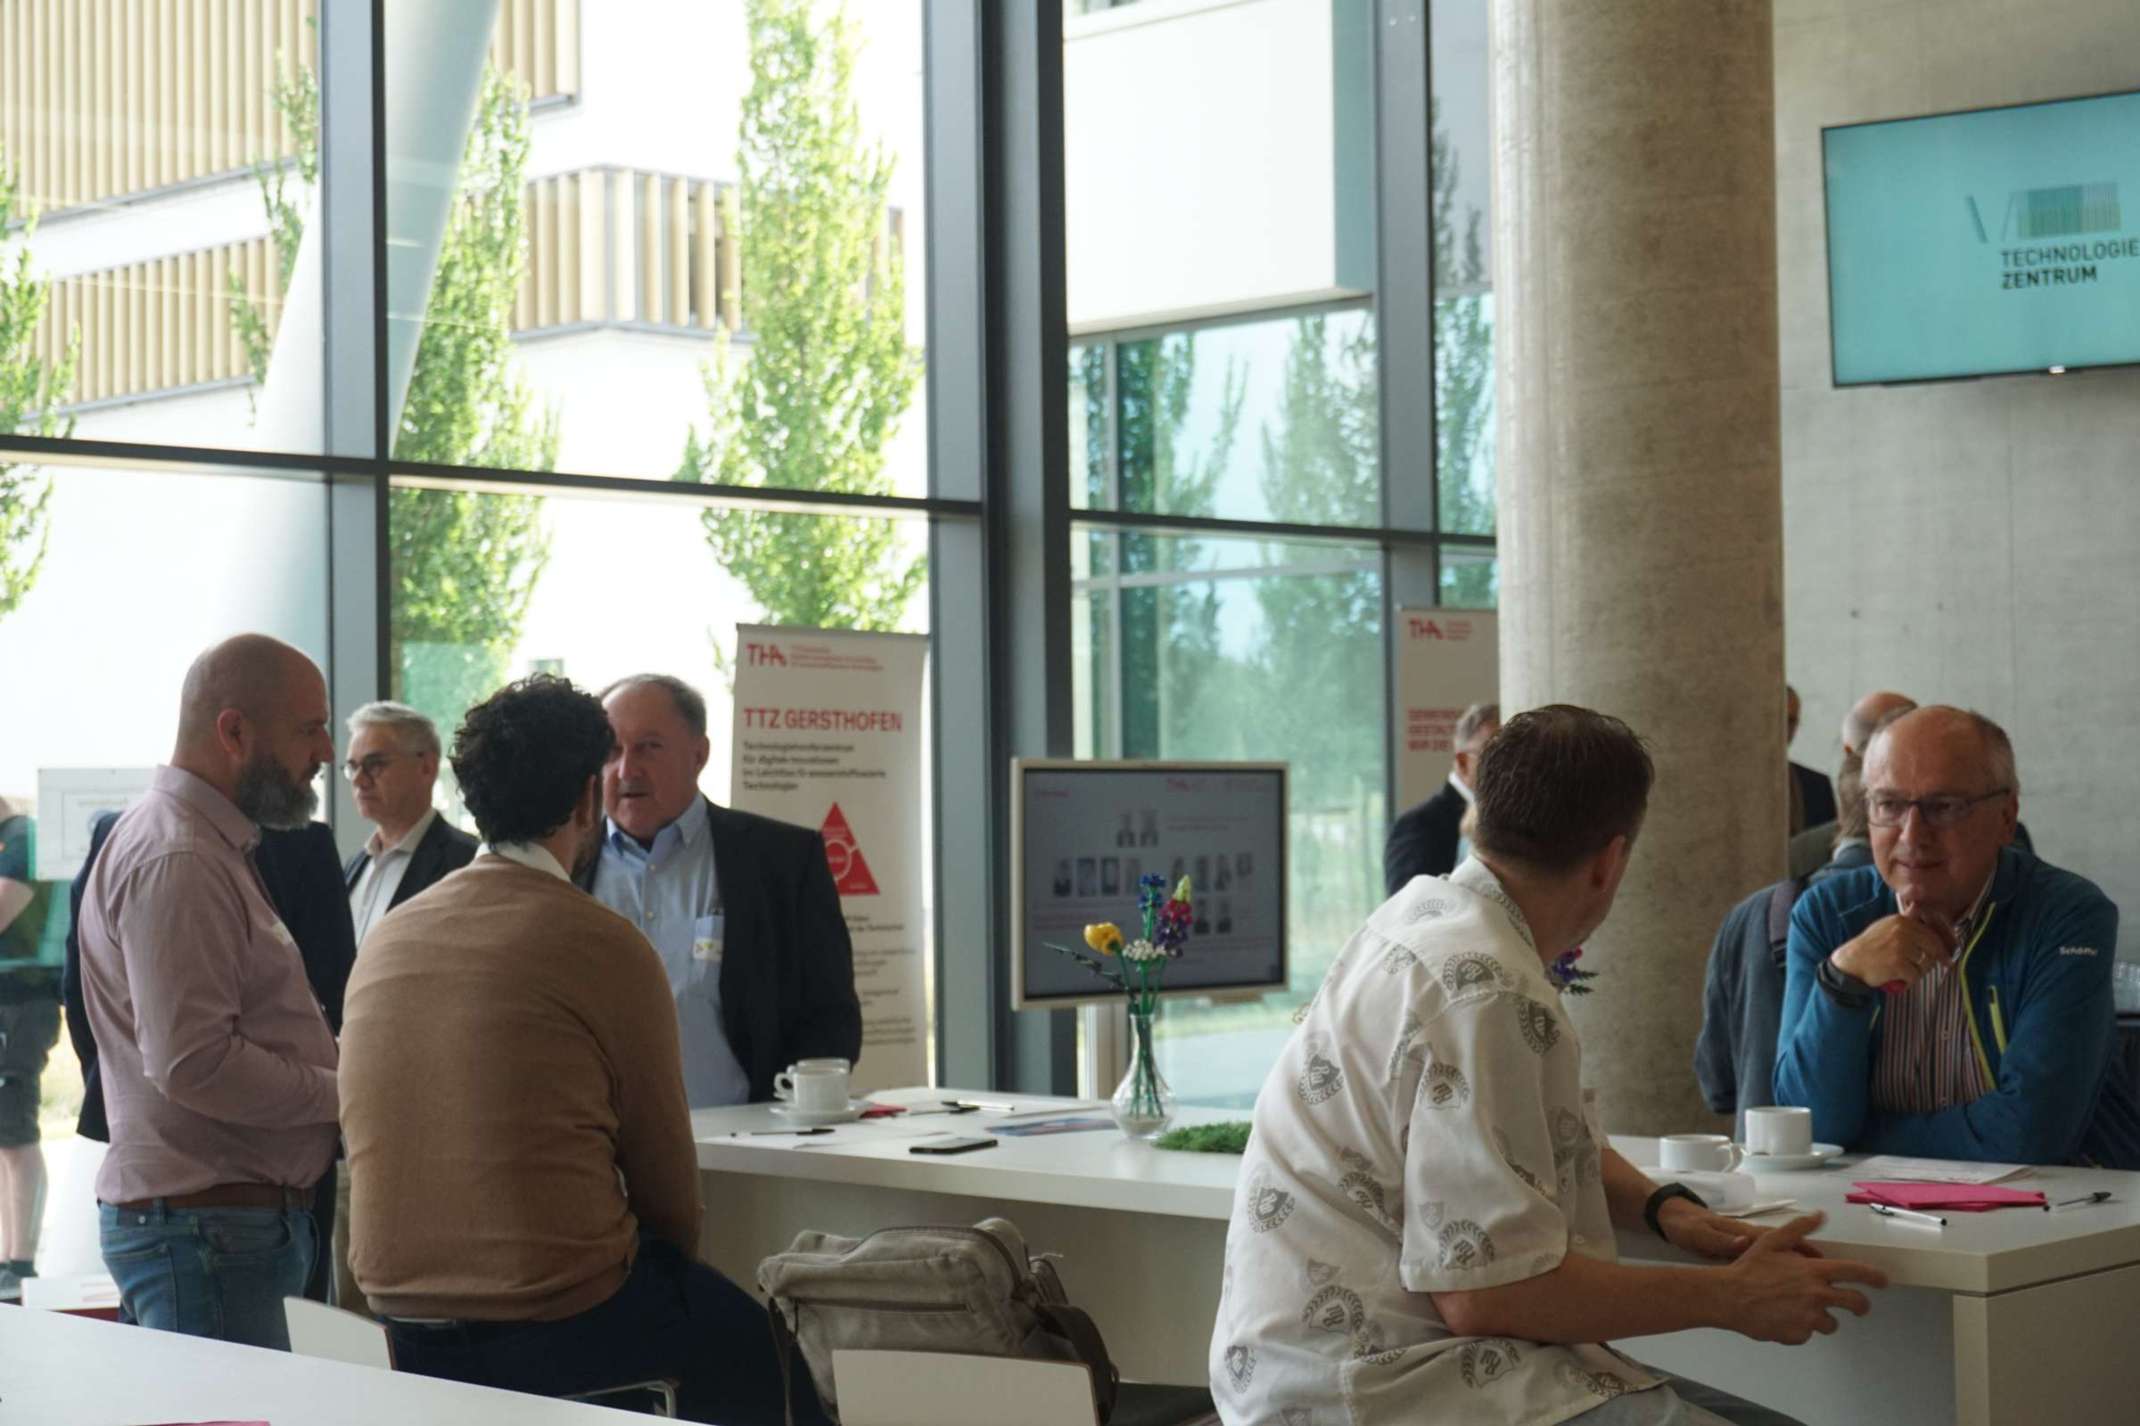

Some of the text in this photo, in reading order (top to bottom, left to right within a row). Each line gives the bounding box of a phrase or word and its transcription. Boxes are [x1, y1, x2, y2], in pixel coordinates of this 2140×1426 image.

[2001, 239, 2140, 267] TECHNOLOGIE
[2002, 266, 2097, 289] ZENTRUM
[743, 708, 903, 731] TTZ GERSTHOFEN
